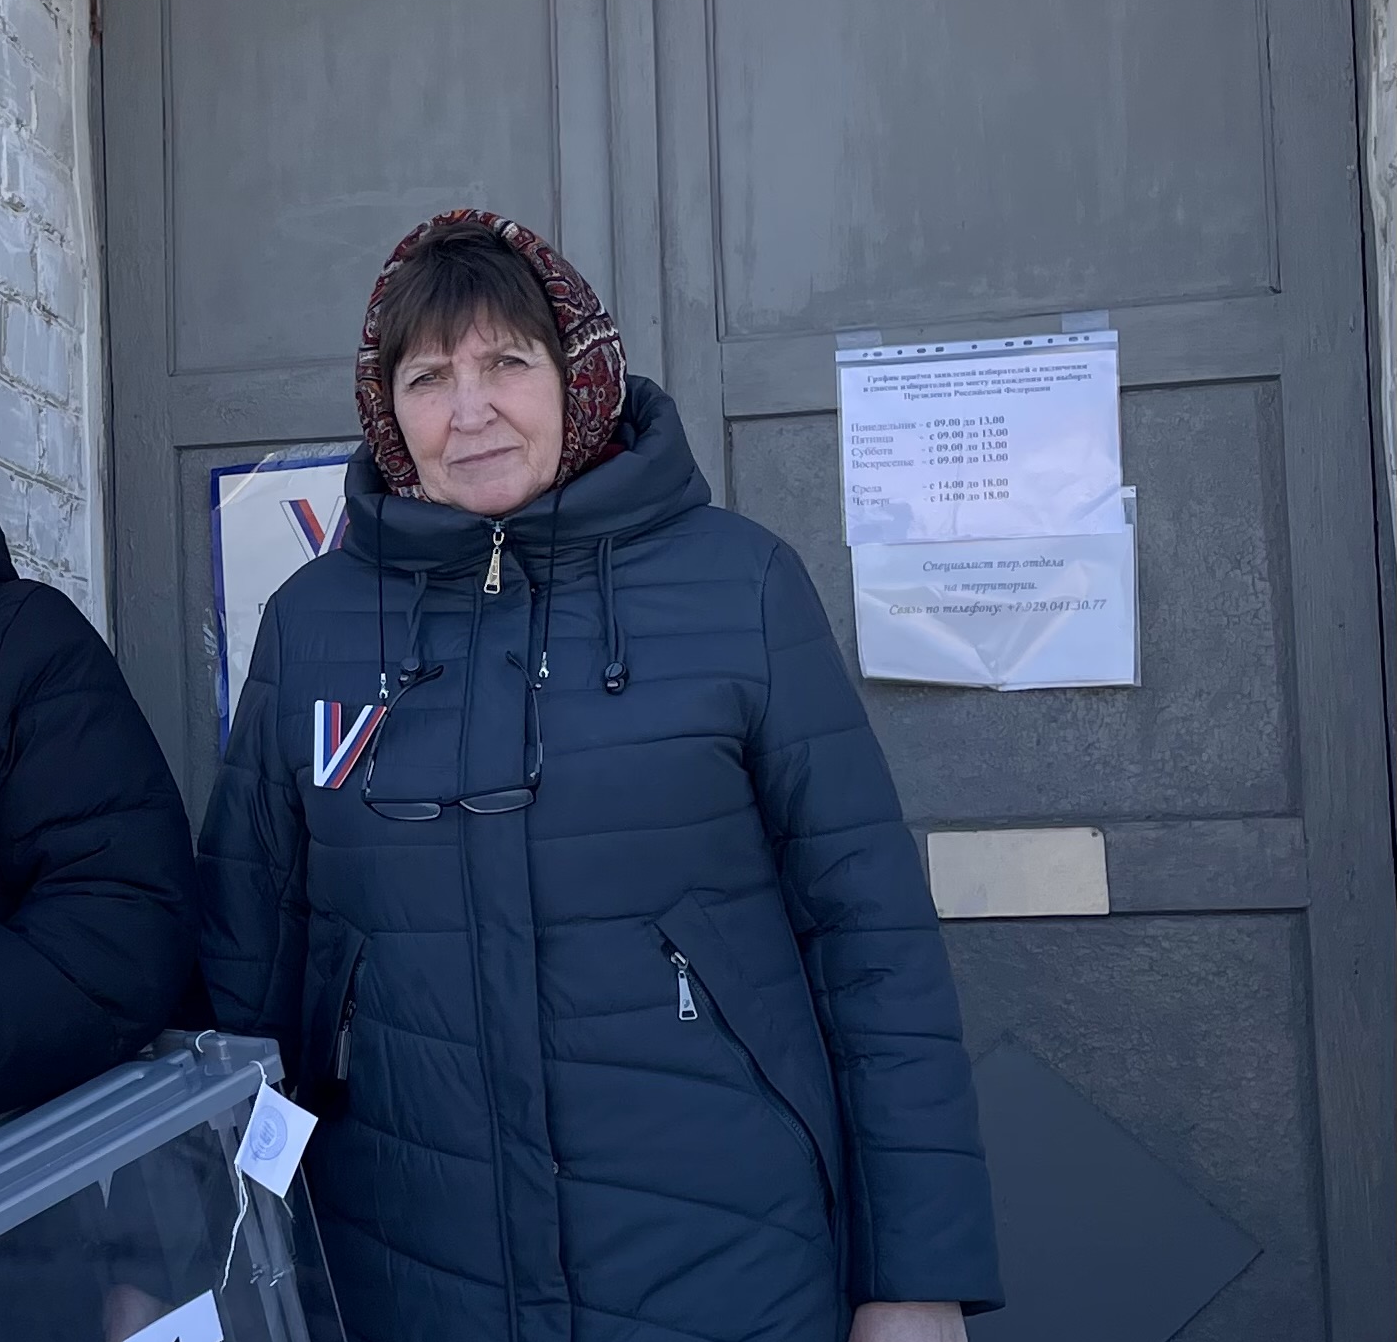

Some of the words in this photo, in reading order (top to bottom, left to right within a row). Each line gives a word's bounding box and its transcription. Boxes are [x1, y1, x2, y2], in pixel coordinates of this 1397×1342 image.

[851, 422, 917, 432] Понедельник
[934, 418, 960, 427] 09.00
[962, 419, 975, 428] до
[978, 415, 1005, 426] 13.00
[851, 434, 894, 445] Пятница
[937, 430, 964, 440] 09.00
[966, 431, 979, 440] до
[982, 428, 1008, 438] 13.00
[851, 447, 893, 458] Суббота
[936, 443, 963, 452] 09.00
[965, 444, 978, 452] до
[981, 441, 1007, 451] 13.00
[937, 455, 964, 464] 09.00
[966, 456, 979, 465] до
[982, 453, 1008, 463] 13.00
[852, 485, 882, 494] Среда
[938, 480, 964, 490] 14.00
[966, 481, 979, 490] до
[982, 478, 1008, 488] 18.00
[939, 492, 964, 502] 14.00
[967, 493, 979, 502] до
[983, 490, 1009, 500] 18.00
[923, 560, 993, 573] Специалист
[944, 583, 957, 592] на
[961, 581, 1038, 594] территории.
[889, 604, 923, 616] Связь
[925, 606, 940, 615] по
[943, 601, 1002, 617] телефону:
